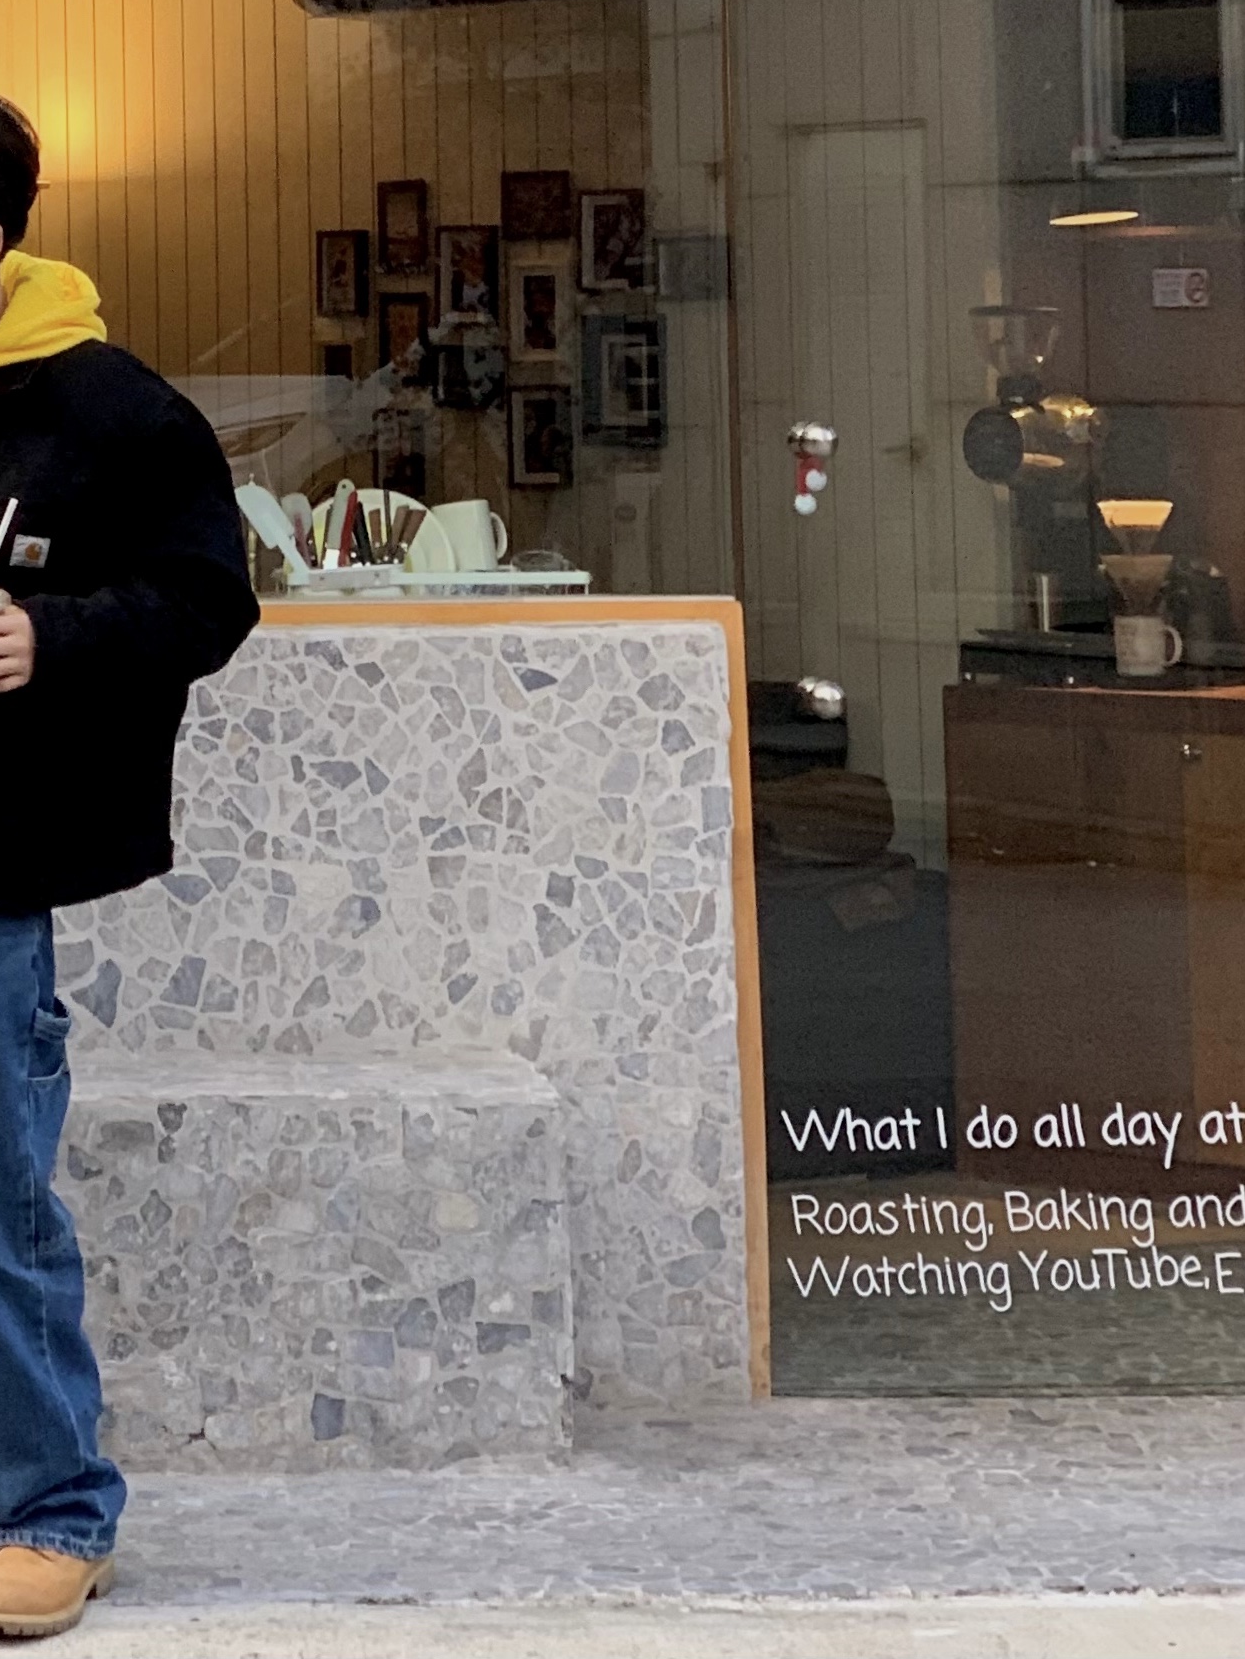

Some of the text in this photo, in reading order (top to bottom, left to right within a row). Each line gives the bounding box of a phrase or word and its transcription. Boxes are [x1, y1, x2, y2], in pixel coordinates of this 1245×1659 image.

[780, 1101, 1245, 1169] What I do all day at
[1004, 1188, 1154, 1247] Baking
[1169, 1183, 1245, 1230] and
[786, 1251, 1012, 1311] Watching
